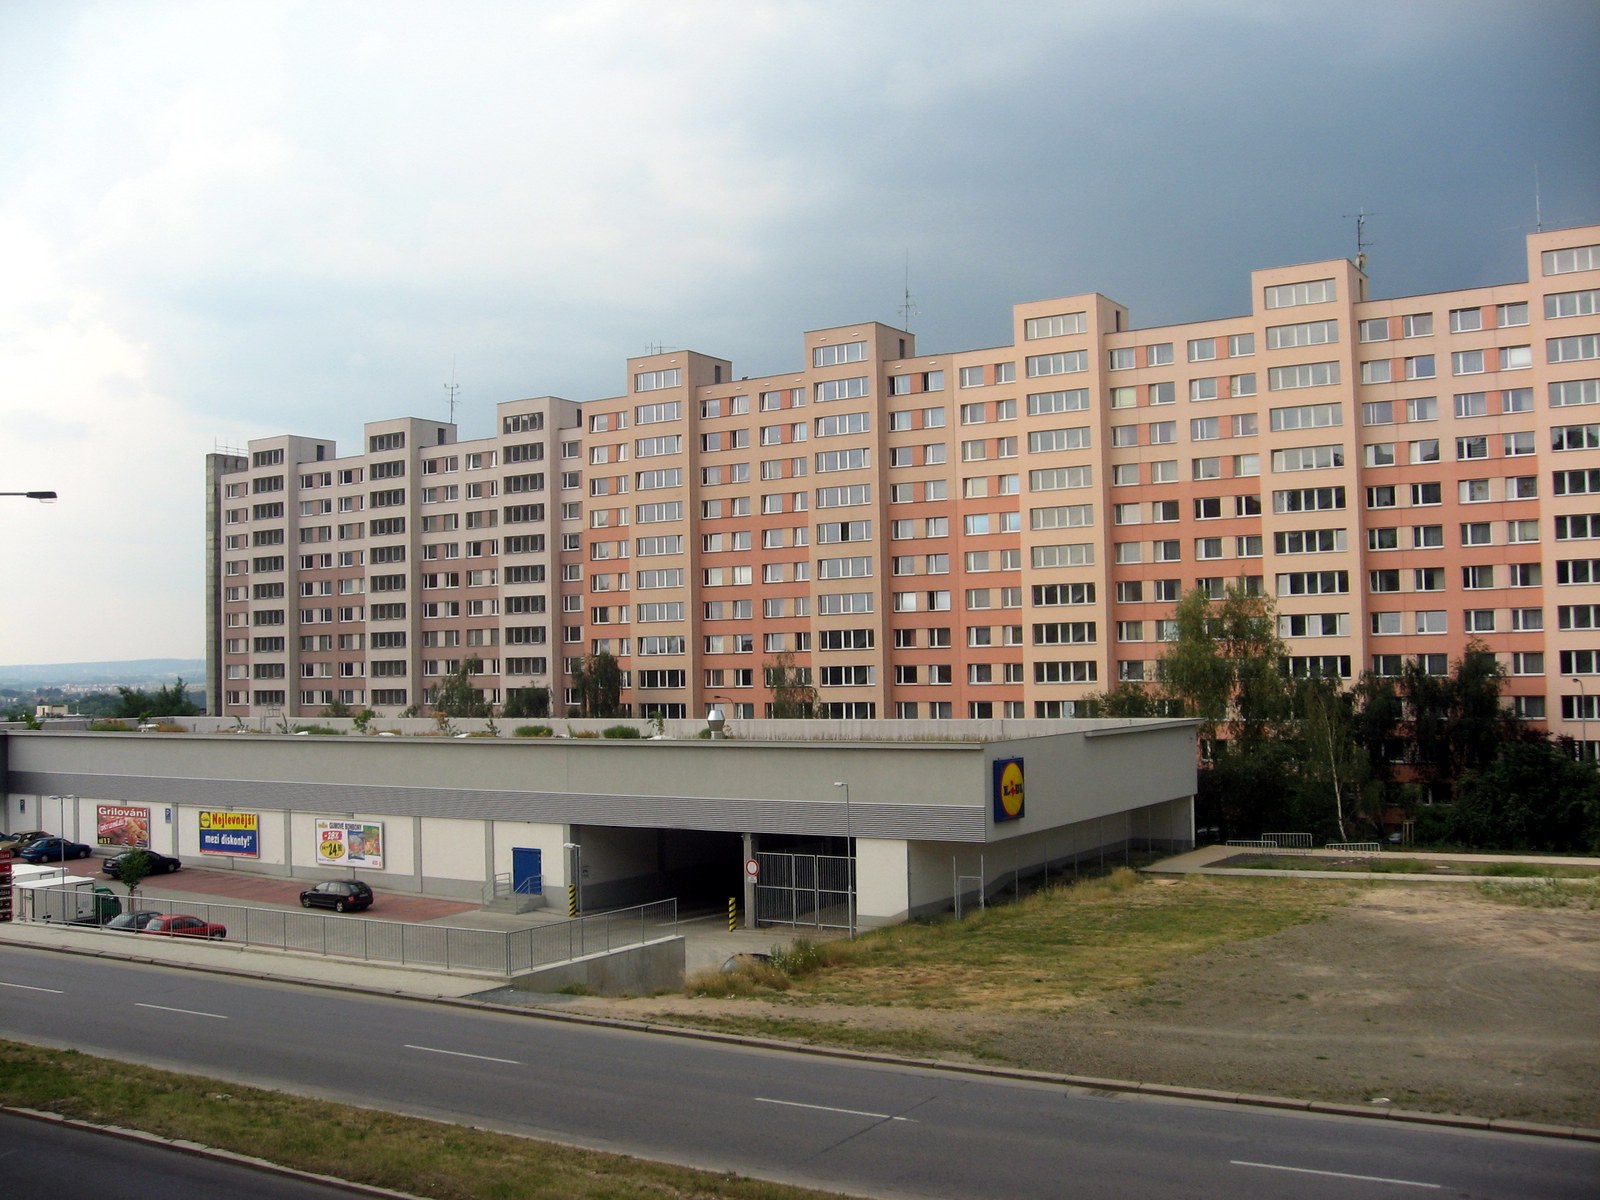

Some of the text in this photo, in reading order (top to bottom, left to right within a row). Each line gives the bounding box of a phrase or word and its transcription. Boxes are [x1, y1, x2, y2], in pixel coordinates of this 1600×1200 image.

[98, 806, 147, 818] Grilování
[212, 813, 254, 828] Nejlevnější
[205, 833, 219, 844] mezi
